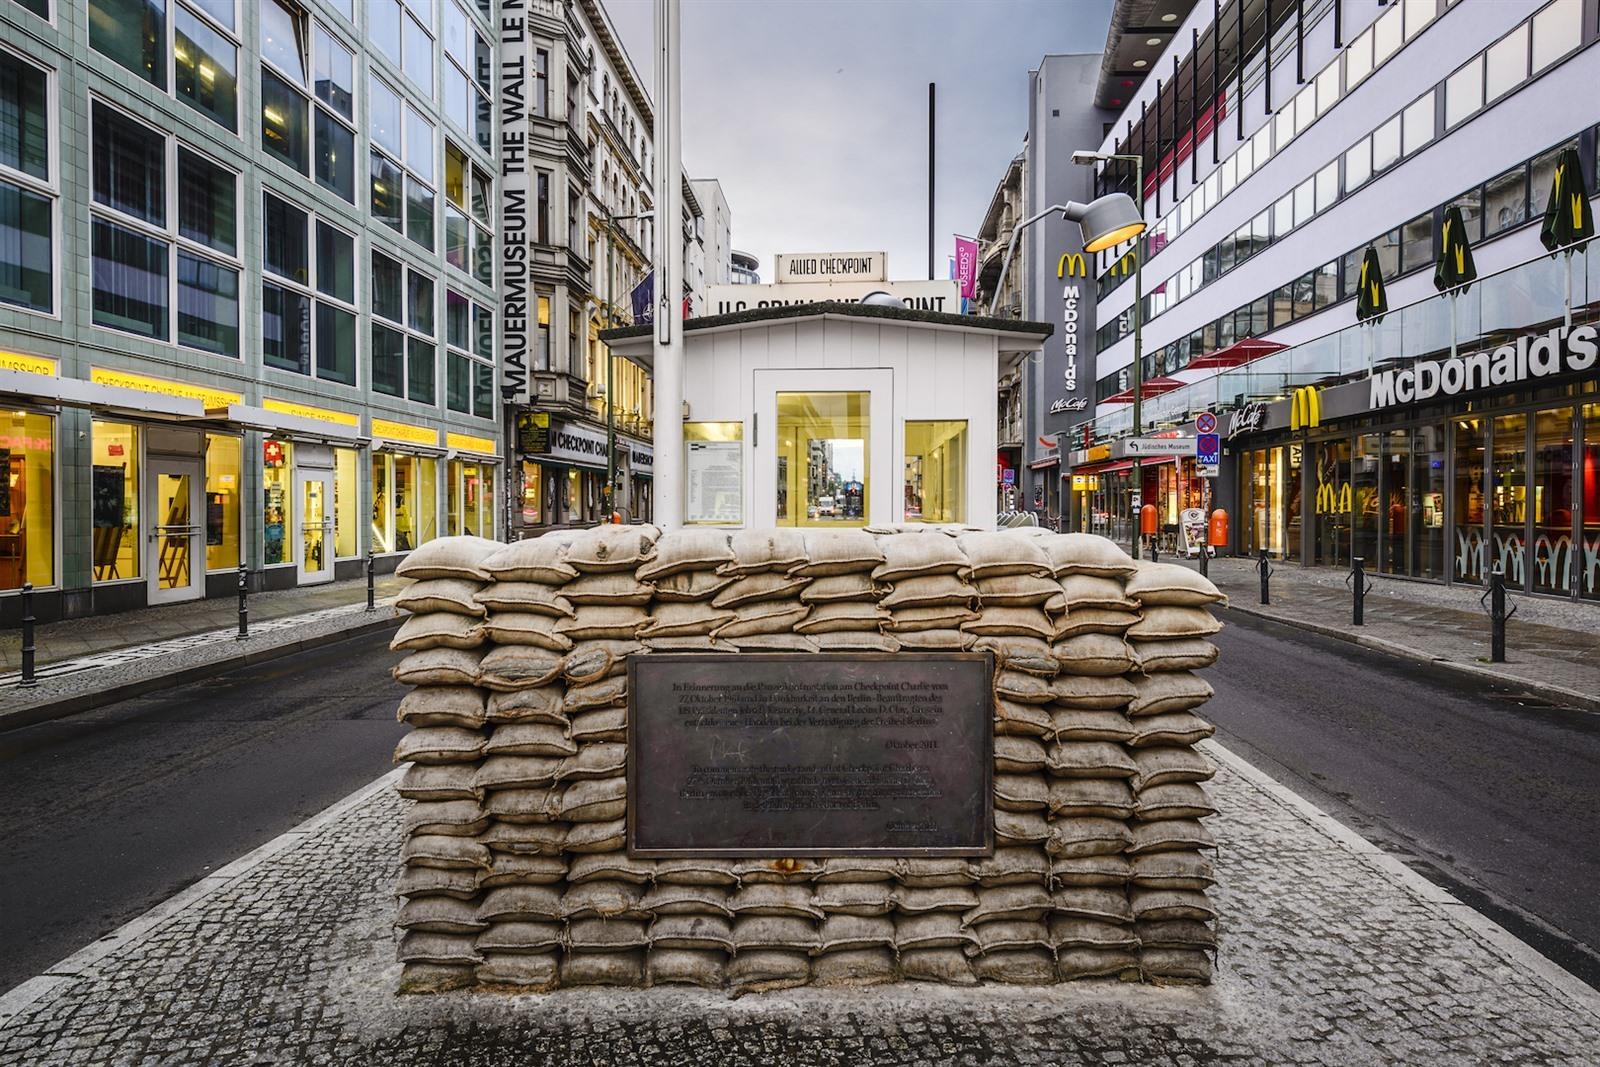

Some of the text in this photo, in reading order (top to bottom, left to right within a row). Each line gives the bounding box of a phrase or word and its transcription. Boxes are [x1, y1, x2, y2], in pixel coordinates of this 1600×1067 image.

[502, 17, 525, 43] LE
[502, 56, 525, 125] WALL
[502, 131, 525, 177] THE
[789, 257, 873, 275] ALLIED CHECKPOINT
[503, 189, 527, 394] MAUERMUSEUM
[1369, 325, 1598, 409] McDonald's
[1198, 454, 1218, 463] TAXI
